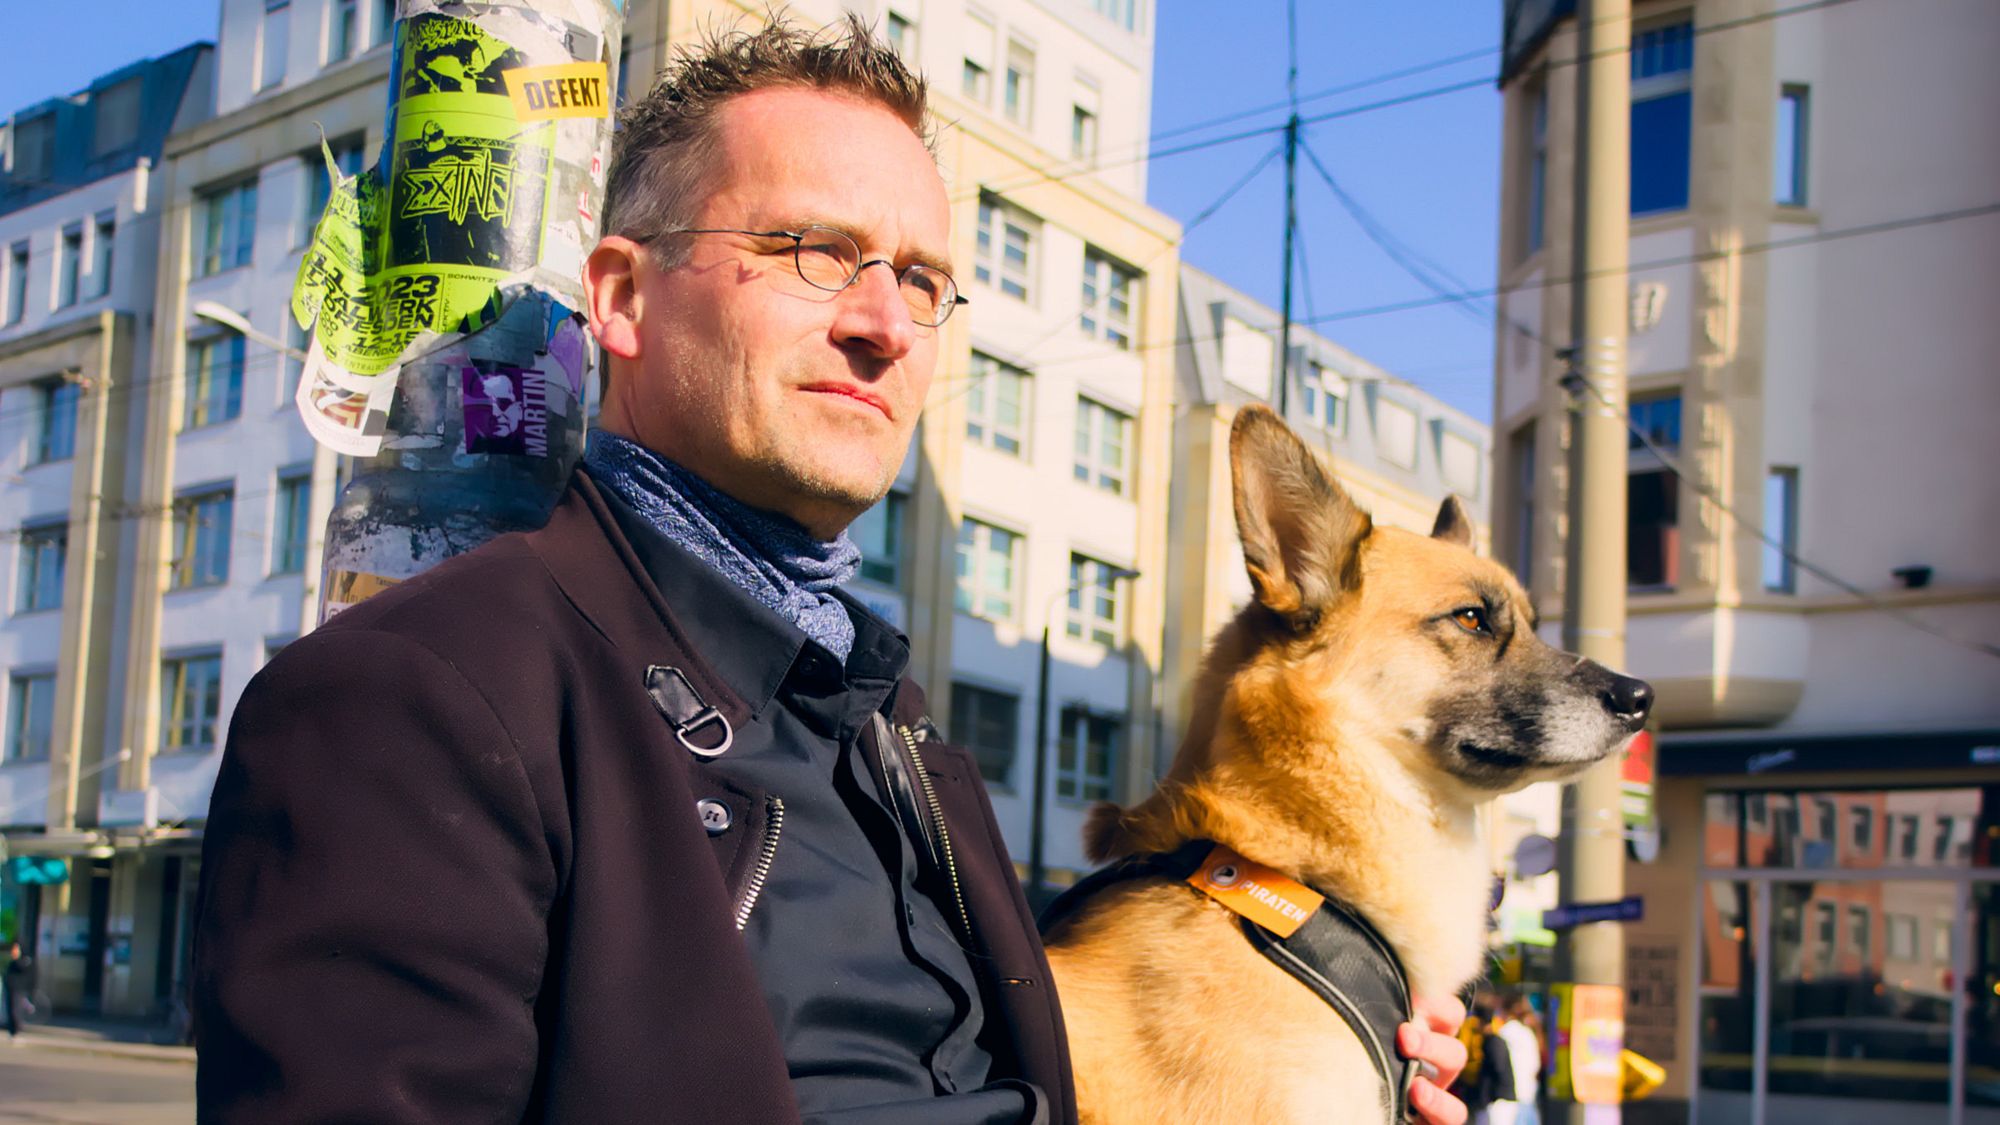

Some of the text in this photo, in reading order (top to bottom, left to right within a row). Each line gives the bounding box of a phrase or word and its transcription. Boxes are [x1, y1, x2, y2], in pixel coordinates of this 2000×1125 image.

[523, 77, 600, 111] DEFEKT
[522, 371, 548, 457] MARTIN
[1239, 879, 1307, 922] PIRATEN
